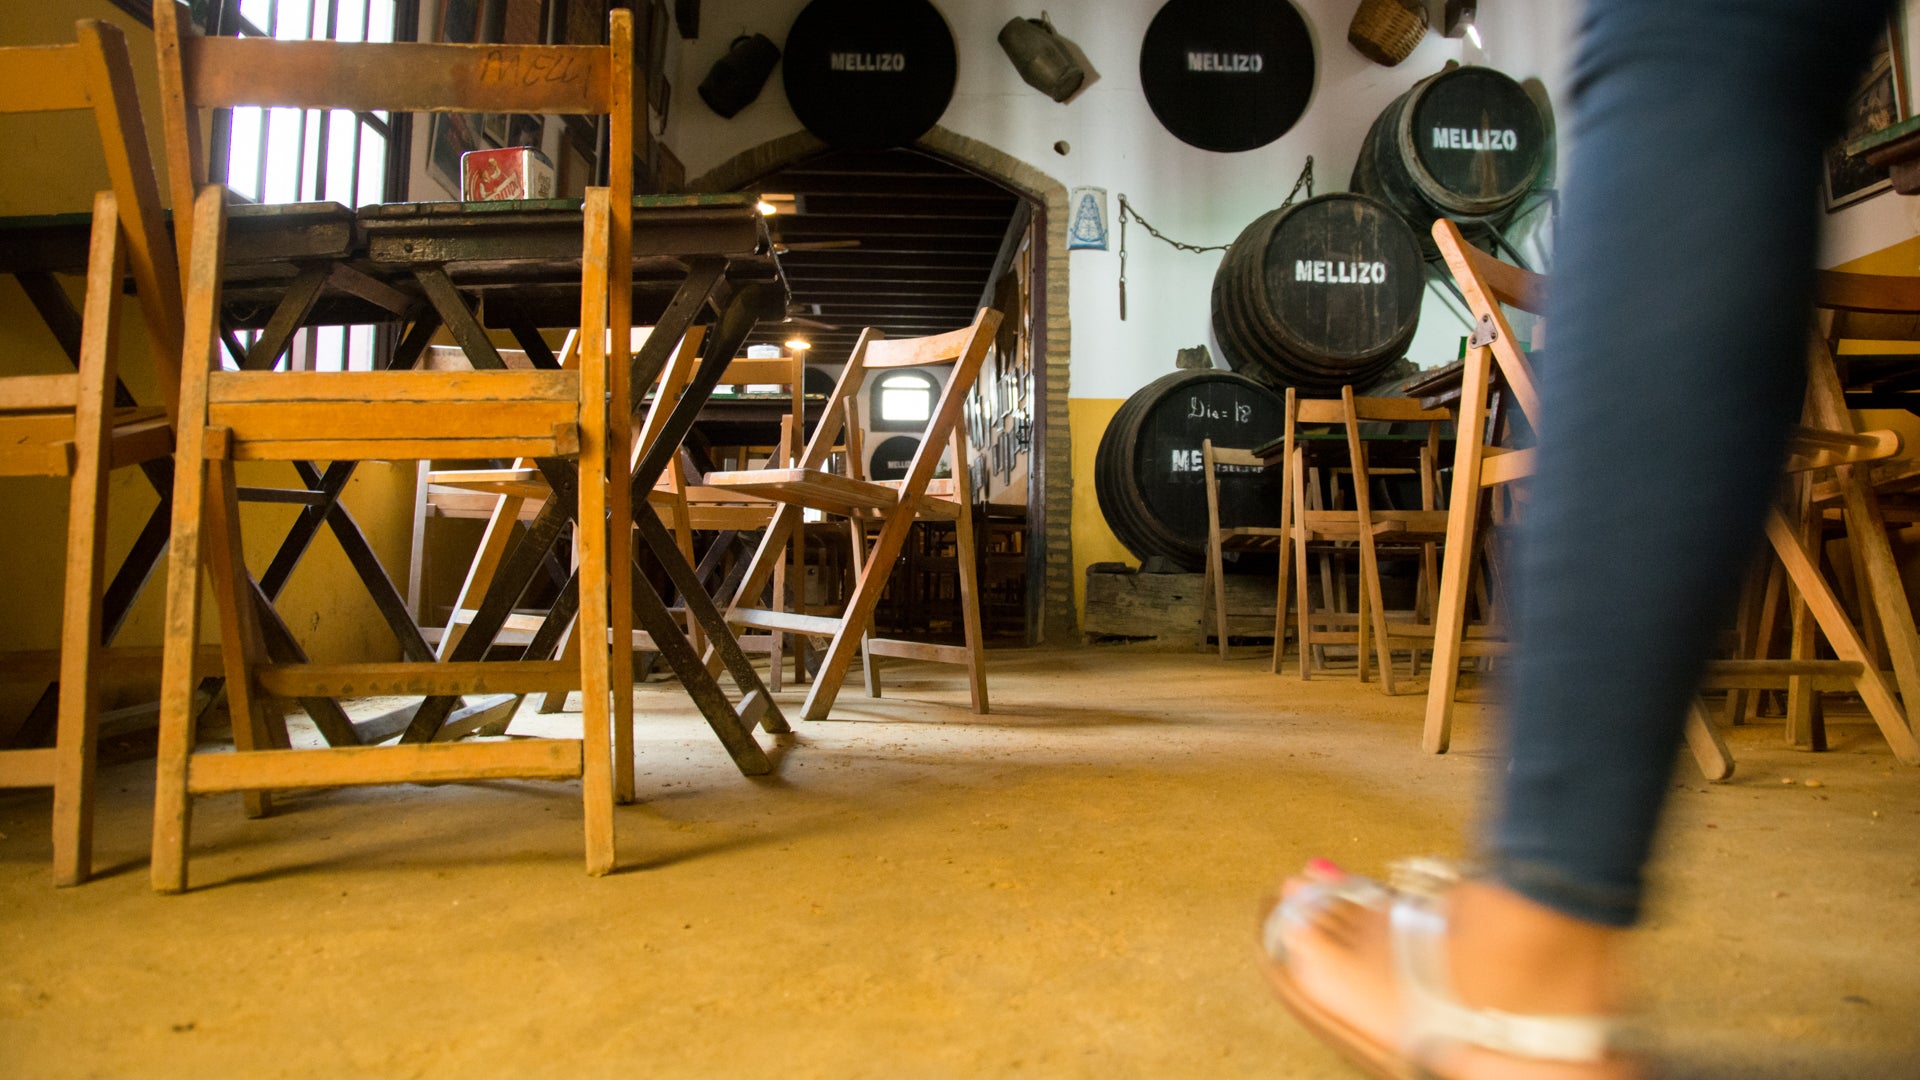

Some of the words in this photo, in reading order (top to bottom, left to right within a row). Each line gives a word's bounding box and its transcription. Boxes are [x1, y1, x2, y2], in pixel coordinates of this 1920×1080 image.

[831, 53, 905, 71] MELLIZO
[1188, 52, 1262, 72] MELLIZO
[1432, 127, 1517, 151] MELLIZO
[1295, 260, 1385, 283] MELLIZO
